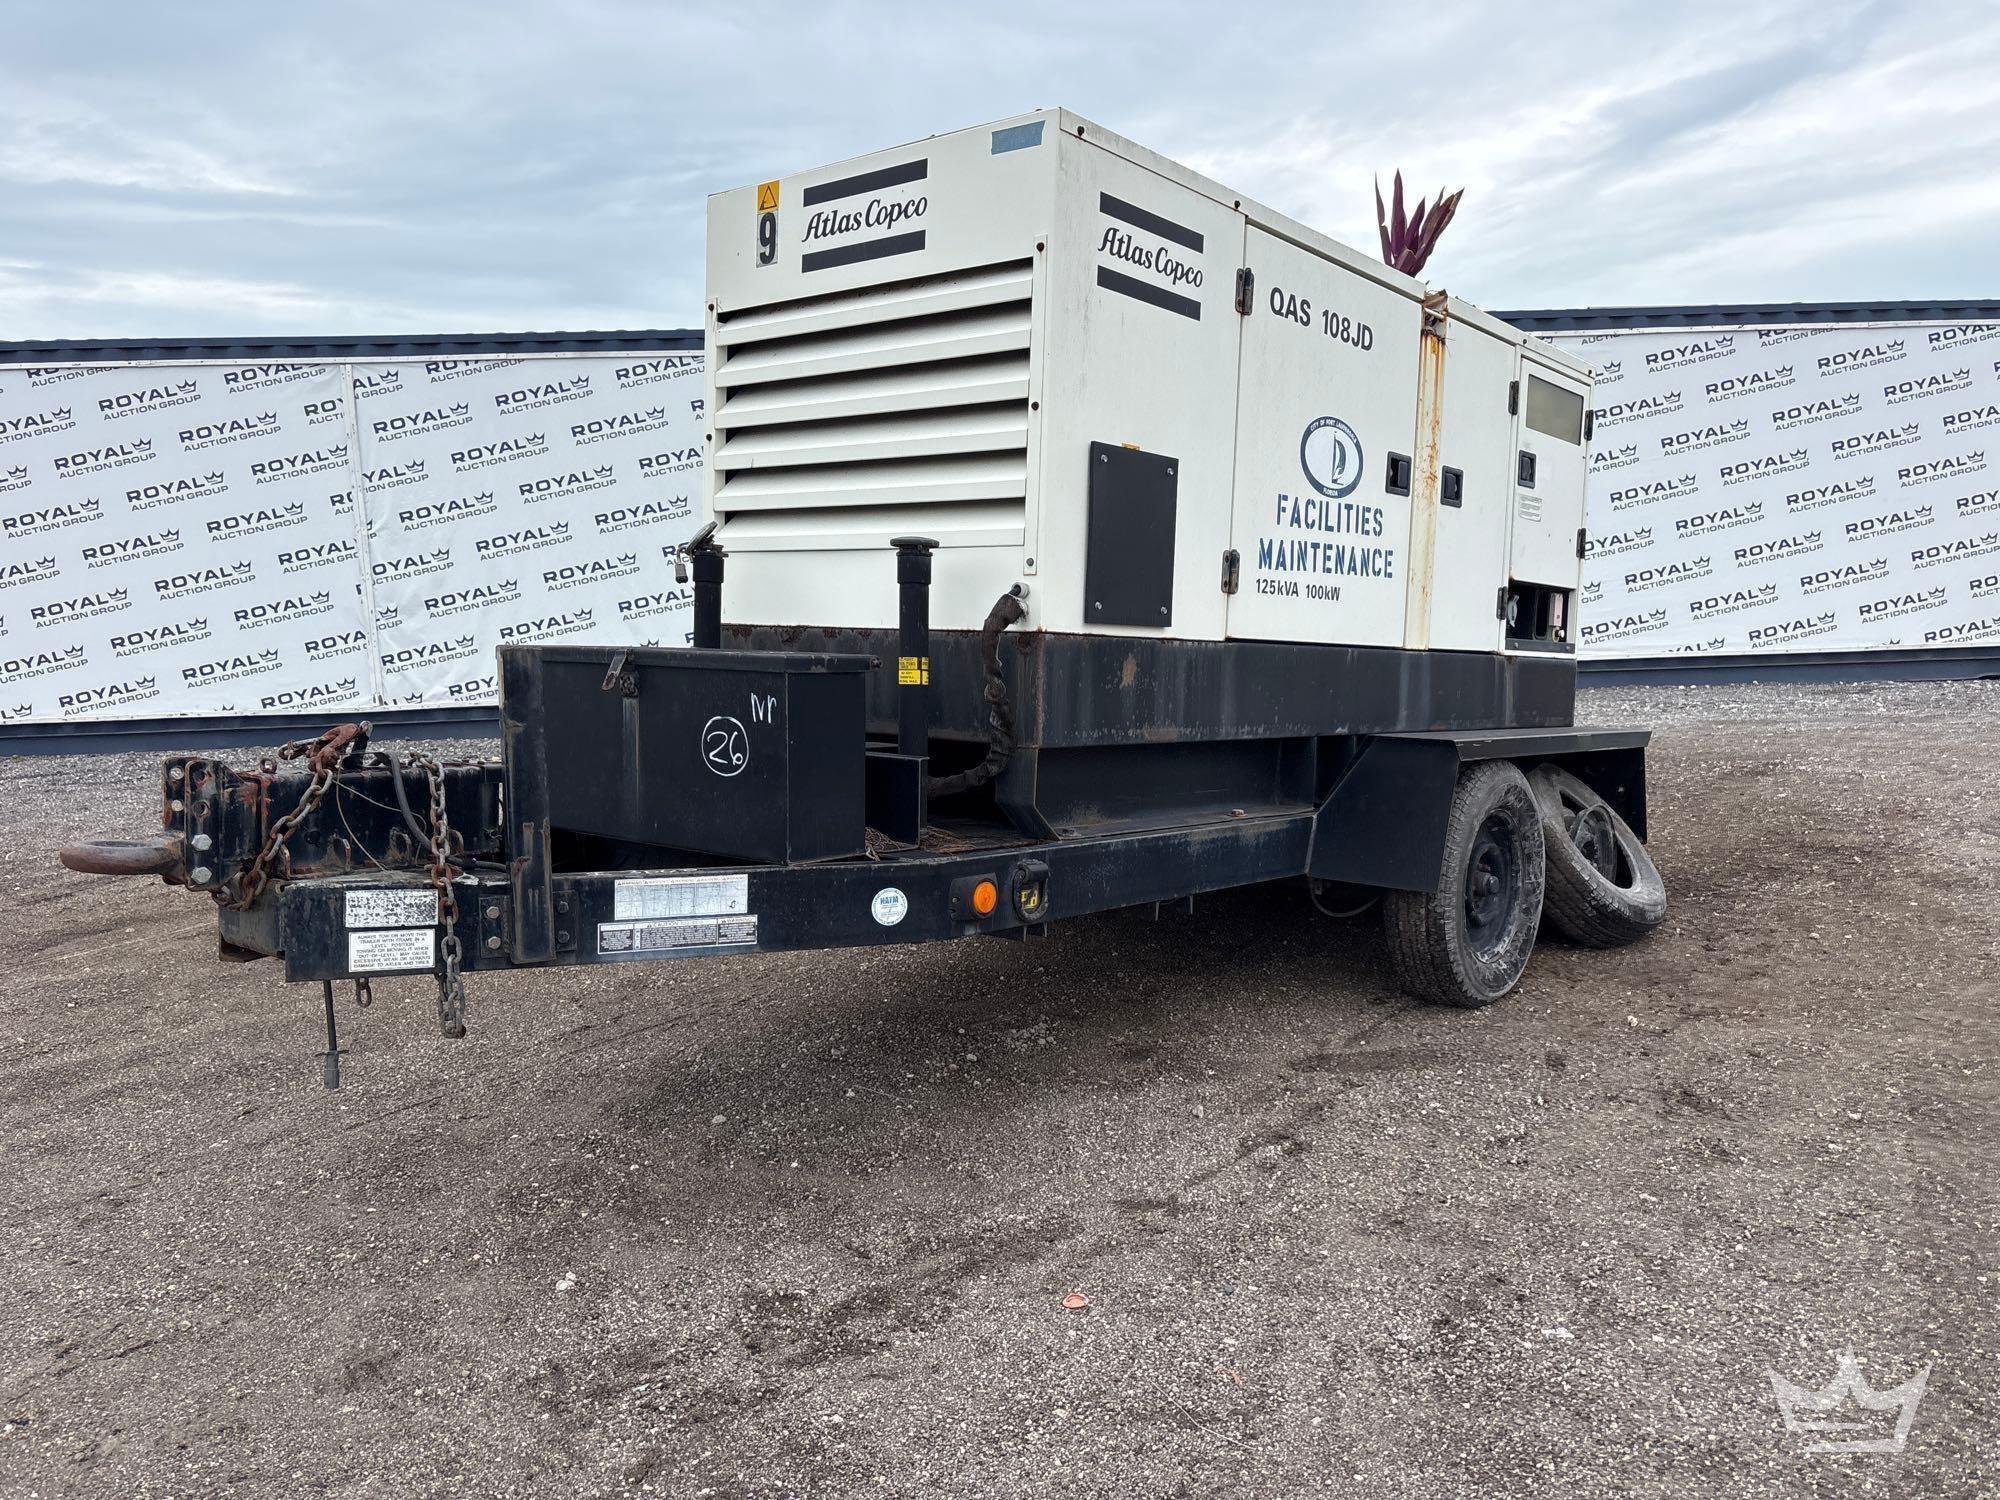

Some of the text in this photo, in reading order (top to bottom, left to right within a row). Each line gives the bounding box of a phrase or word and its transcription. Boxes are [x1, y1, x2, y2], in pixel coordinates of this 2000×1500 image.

[802, 196, 928, 241] Atlas Copco
[759, 212, 777, 263] 9
[1098, 227, 1203, 288] Atlas Copco
[1270, 287, 1374, 351] QAS 108JD
[1646, 341, 1716, 365] ROYAL
[1649, 348, 1736, 374] AUCTION GROUP
[1817, 345, 1887, 369] ROYAL
[1820, 352, 1907, 378] AUCTION GROUP
[495, 382, 571, 407] ROYAL
[1705, 371, 1776, 395] ROYAL
[1708, 378, 1796, 404] AUCTION GROUP
[1884, 374, 1953, 397] ROYAL
[1887, 381, 1972, 406] AUCTION GROUP
[98, 386, 178, 412] ROYAL
[104, 394, 201, 421] AUCTION GROUP
[500, 390, 593, 416] AUCTION GROUP
[178, 418, 258, 443] ROYAL
[373, 409, 451, 434] ROYAL
[378, 416, 473, 443] AUCTION GROUP
[571, 413, 647, 438] ROYAL
[576, 421, 668, 446] AUCTION GROUP
[1310, 422, 1319, 431] CITY
[184, 426, 281, 452] AUCTION GROUP
[1660, 425, 1730, 449] ROYAL
[1664, 432, 1750, 457] AUCTION GROUP
[1832, 429, 1902, 452] ROYAL
[1834, 435, 1921, 461] AUCTION GROUP
[54, 444, 133, 470] ROYAL
[450, 439, 527, 464] ROYAL
[456, 447, 549, 473] AUCTION GROUP
[60, 452, 156, 479] AUCTION GROUP
[1898, 456, 1967, 480] ROYAL
[1901, 463, 1987, 488] AUCTION GROUP
[126, 477, 205, 503] ROYAL
[519, 471, 595, 496] ROYAL
[524, 479, 616, 504] AUCTION GROUP
[1323, 488, 1338, 496] FLORIDA
[1610, 480, 1679, 503] ROYAL
[132, 485, 229, 512] AUCTION GROUP
[1613, 487, 1698, 511] AUCTION GROUP
[2, 504, 81, 530] ROYAL
[8, 512, 104, 539] AUCTION GROUP
[206, 508, 285, 533] ROYAL
[594, 501, 670, 526] ROYAL
[600, 509, 692, 534] AUCTION GROUP
[1277, 494, 1383, 537] FACILITIES
[1845, 511, 1915, 535] ROYAL
[212, 516, 308, 542] AUCTION GROUP
[475, 527, 551, 552] ROYAL
[1848, 518, 1935, 542] AUCTION GROUP
[82, 535, 161, 560] ROYAL
[88, 543, 184, 569] AUCTION GROUP
[480, 535, 572, 561] AUCTION GROUP
[1258, 538, 1393, 579] MAINTENANCE
[1734, 536, 1804, 560] ROYAL
[1737, 544, 1824, 568] AUCTION GROUP
[154, 567, 233, 592] ROYAL
[1624, 562, 1693, 585] ROYAL
[1628, 569, 1712, 593] AUCTION GROUP
[160, 574, 256, 601] AUCTION GROUP
[424, 585, 500, 610] ROYAL
[1255, 579, 1340, 601] 125kVA 100kW
[30, 594, 109, 620] ROYAL
[36, 602, 132, 628] AUCTION GROUP
[234, 597, 312, 622] ROYAL
[429, 592, 521, 619] AUCTION GROUP
[1859, 592, 1928, 616] ROYAL
[1862, 600, 1948, 624] AUCTION GROUP
[239, 604, 334, 630] AUCTION GROUP
[381, 641, 457, 666] ROYAL
[386, 648, 478, 675] AUCTION GROUP
[182, 655, 260, 680] ROYAL
[187, 662, 283, 688] AUCTION GROUP
[707, 731, 743, 766] 26
